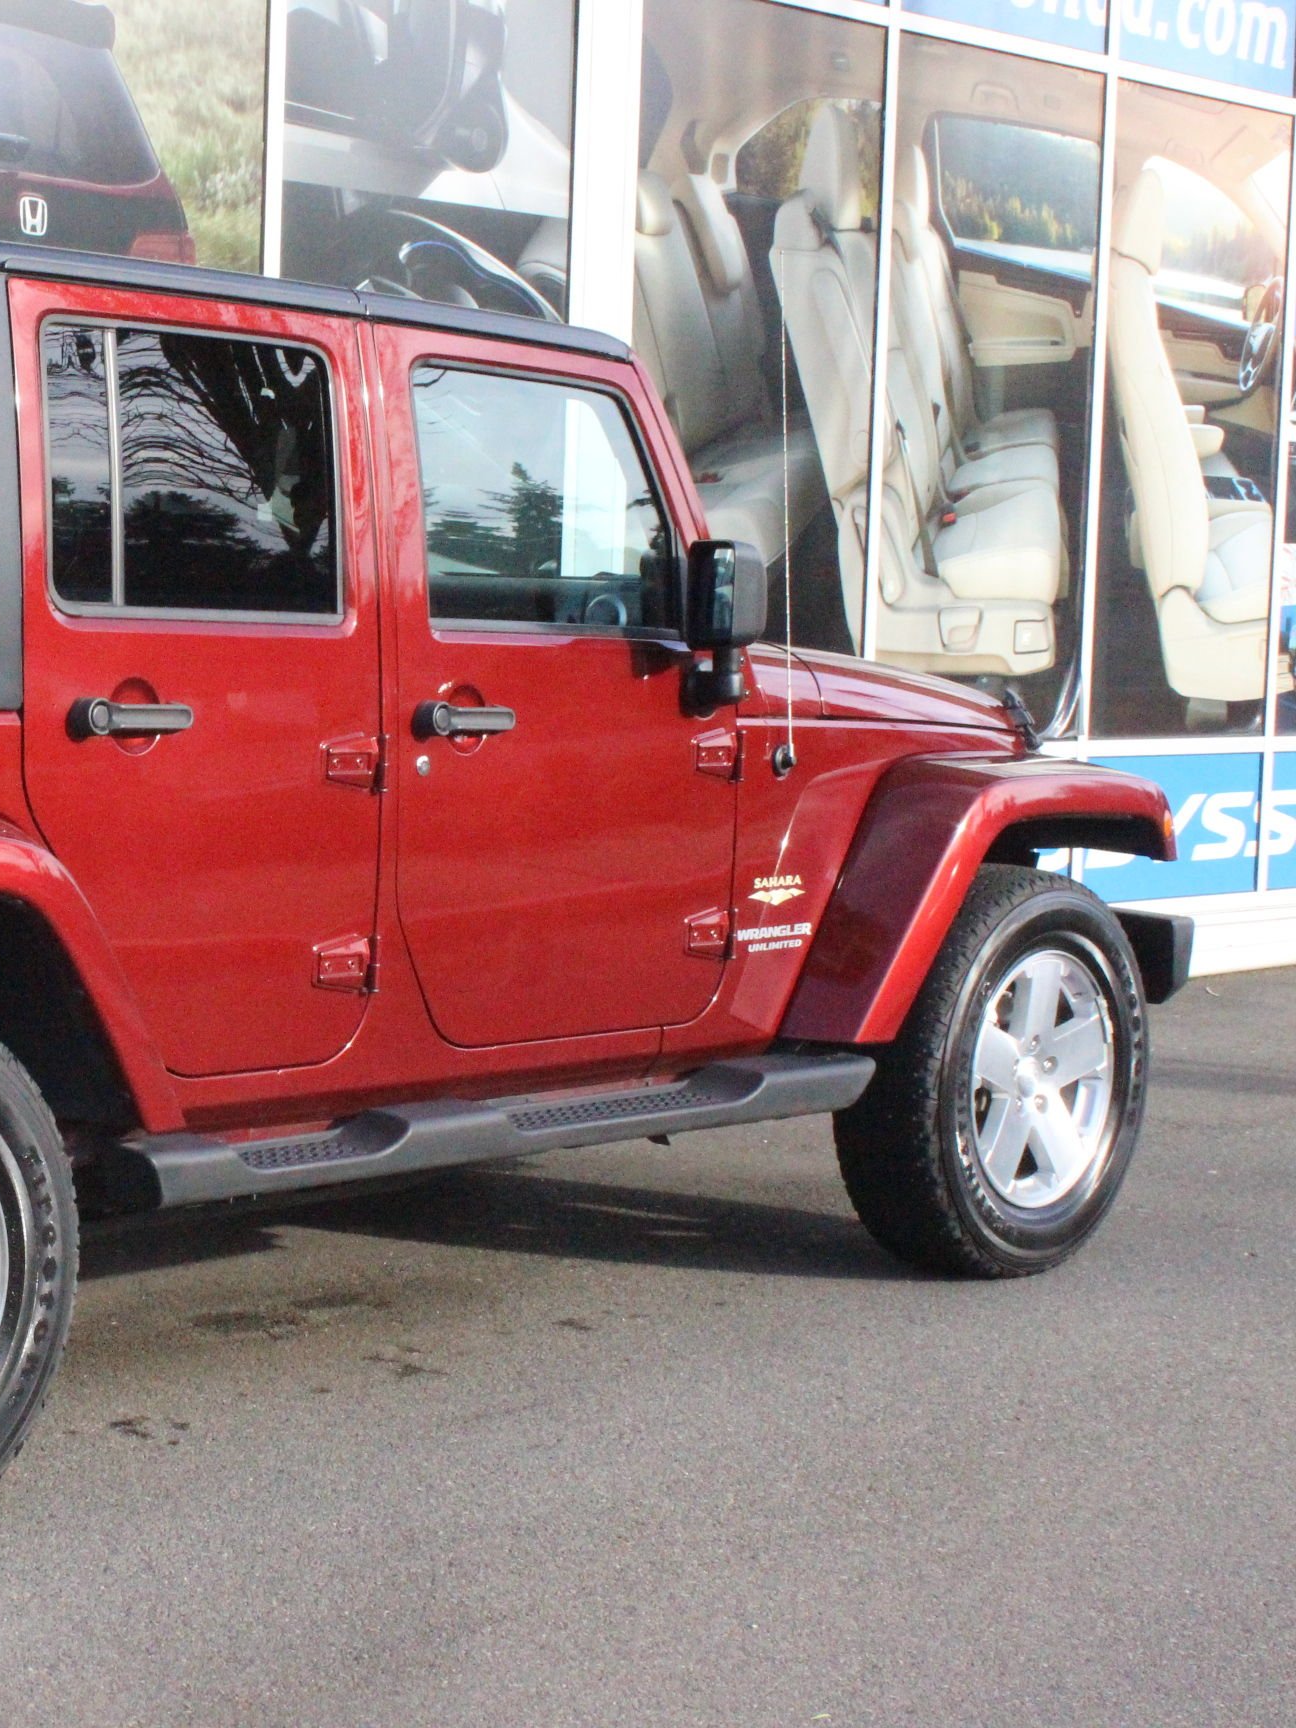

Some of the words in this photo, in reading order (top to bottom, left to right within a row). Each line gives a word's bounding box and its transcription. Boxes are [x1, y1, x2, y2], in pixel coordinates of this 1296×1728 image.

[753, 874, 802, 889] SAHARA
[737, 922, 812, 941] WRANGLER
[748, 939, 802, 953] UNLIMITED
